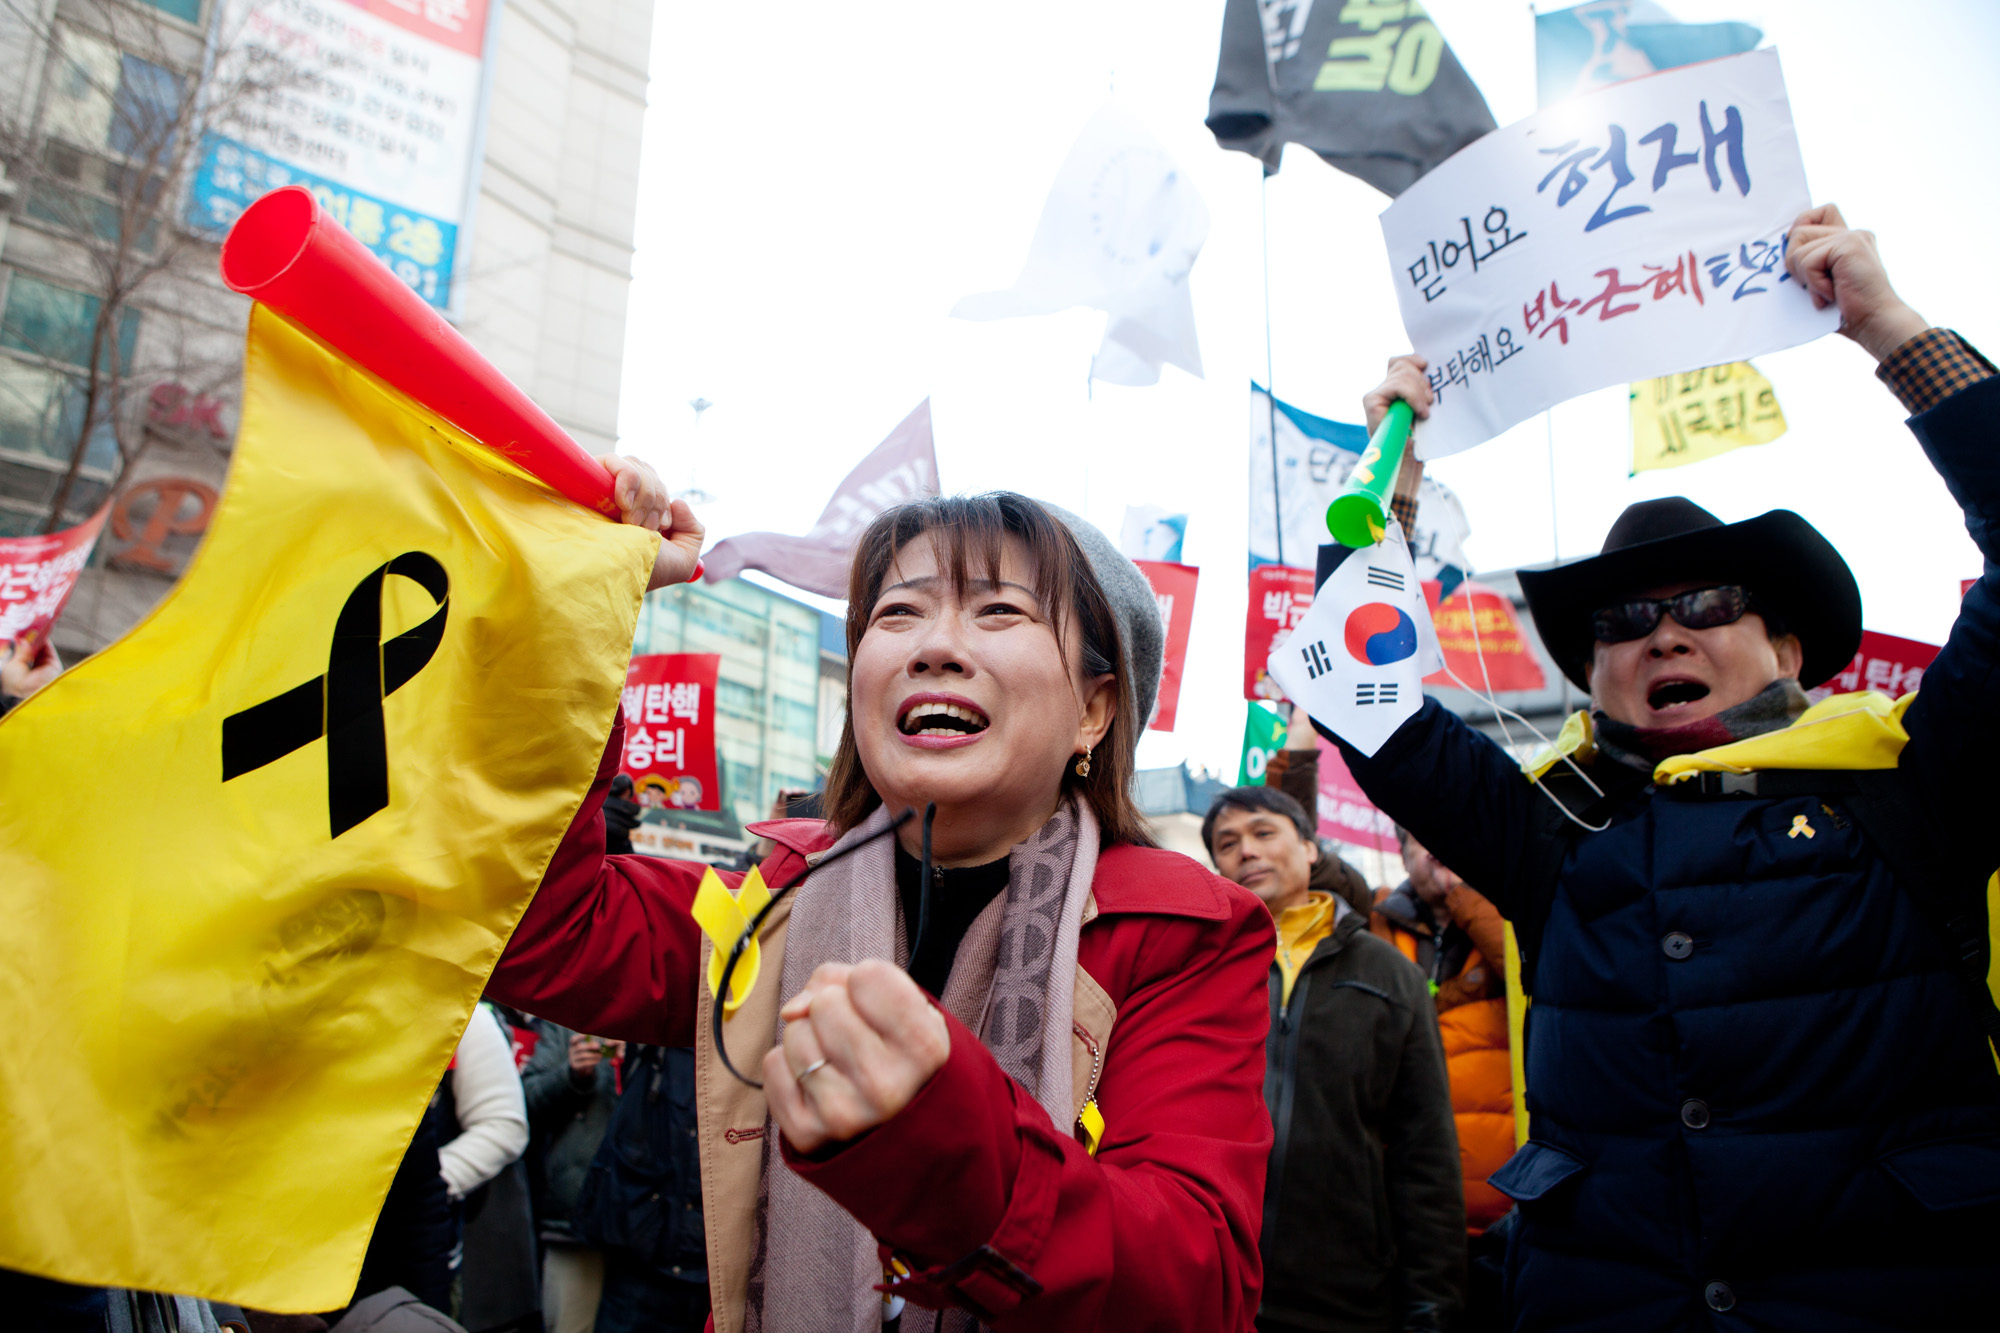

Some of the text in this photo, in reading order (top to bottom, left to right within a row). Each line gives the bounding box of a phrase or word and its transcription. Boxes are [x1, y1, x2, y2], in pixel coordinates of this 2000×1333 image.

[1407, 205, 1528, 303] 믿어요
[1427, 327, 1524, 405] 부탁해요
[1522, 249, 1705, 345] 박근혜
[626, 726, 685, 771] 승리
